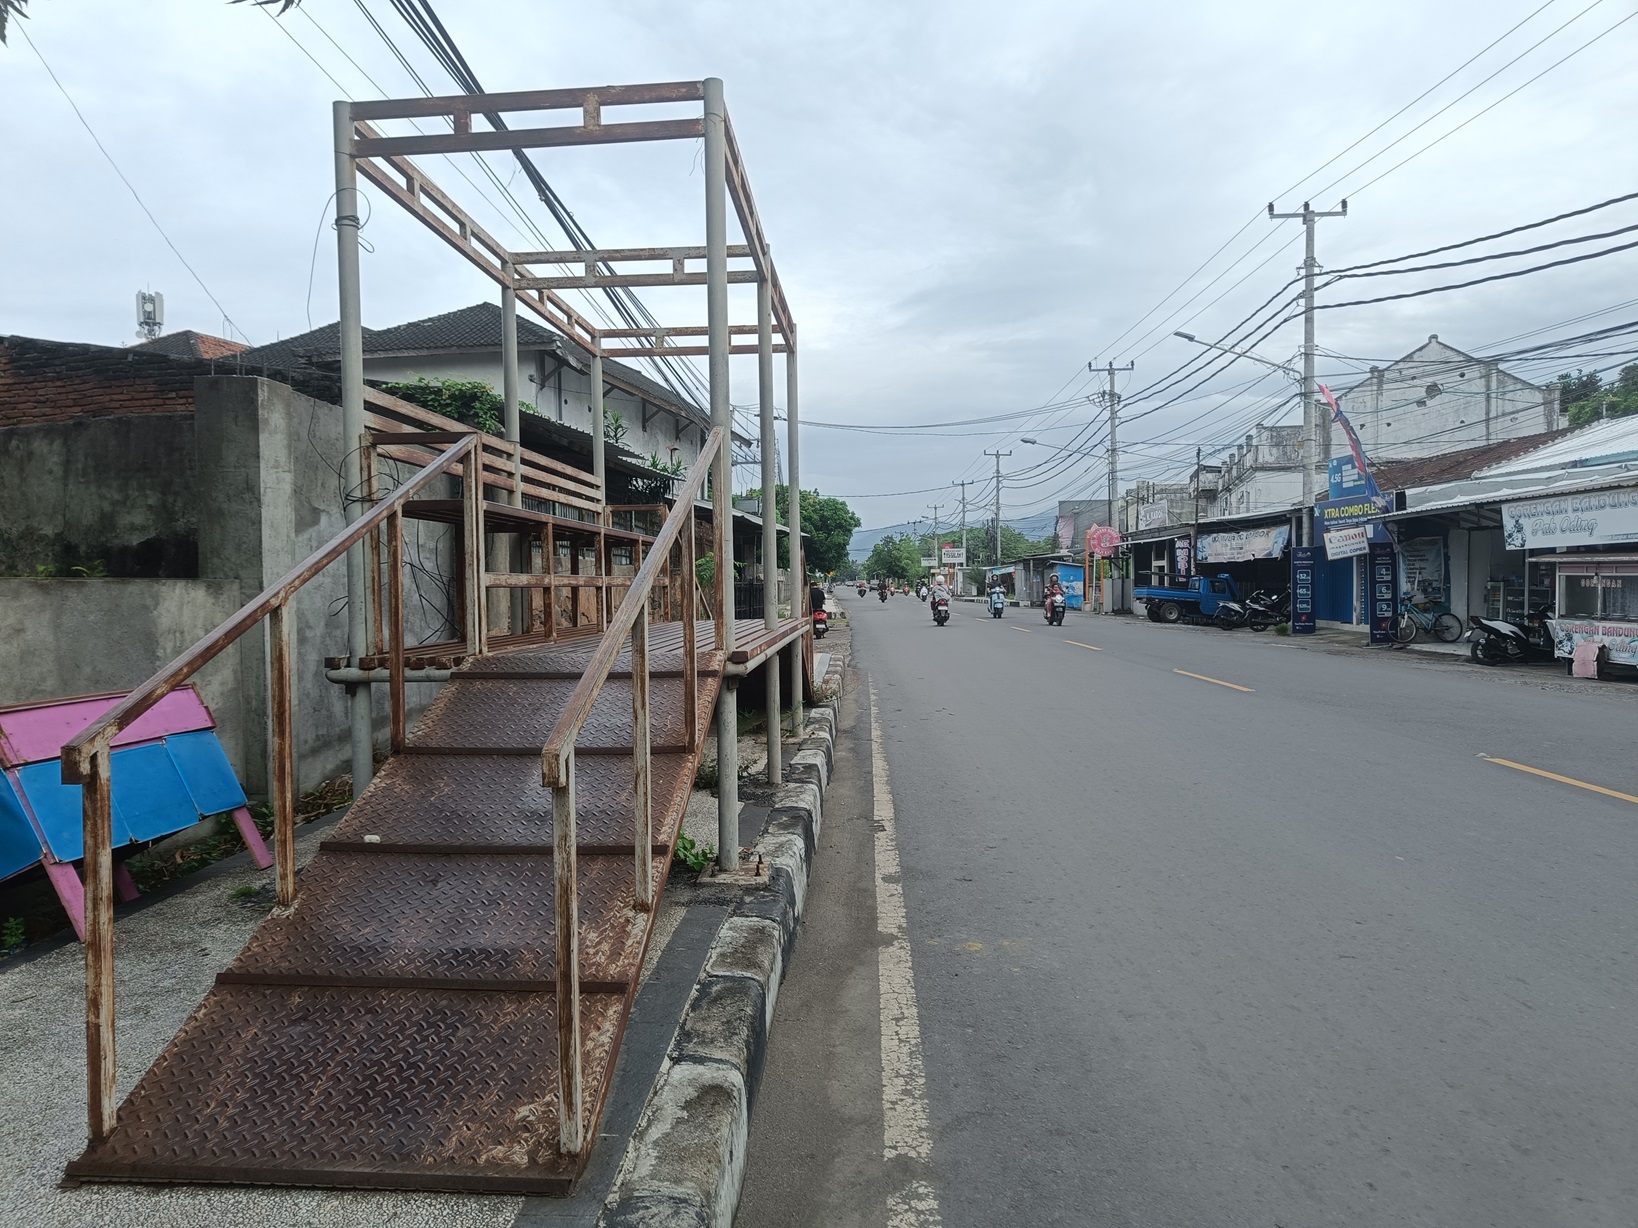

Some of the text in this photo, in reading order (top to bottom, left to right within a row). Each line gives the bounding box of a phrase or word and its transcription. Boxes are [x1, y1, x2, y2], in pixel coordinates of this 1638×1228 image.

[1324, 507, 1340, 519] XTRA
[1340, 504, 1363, 517] COMBO
[1508, 491, 1638, 519] GORENGAN BANDUNG
[1531, 518, 1557, 537] Pak
[1328, 531, 1365, 544] Canon
[1349, 546, 1367, 554] COPIER
[1580, 578, 1622, 588] GORNGAN
[1559, 623, 1600, 636] GORENGAN
